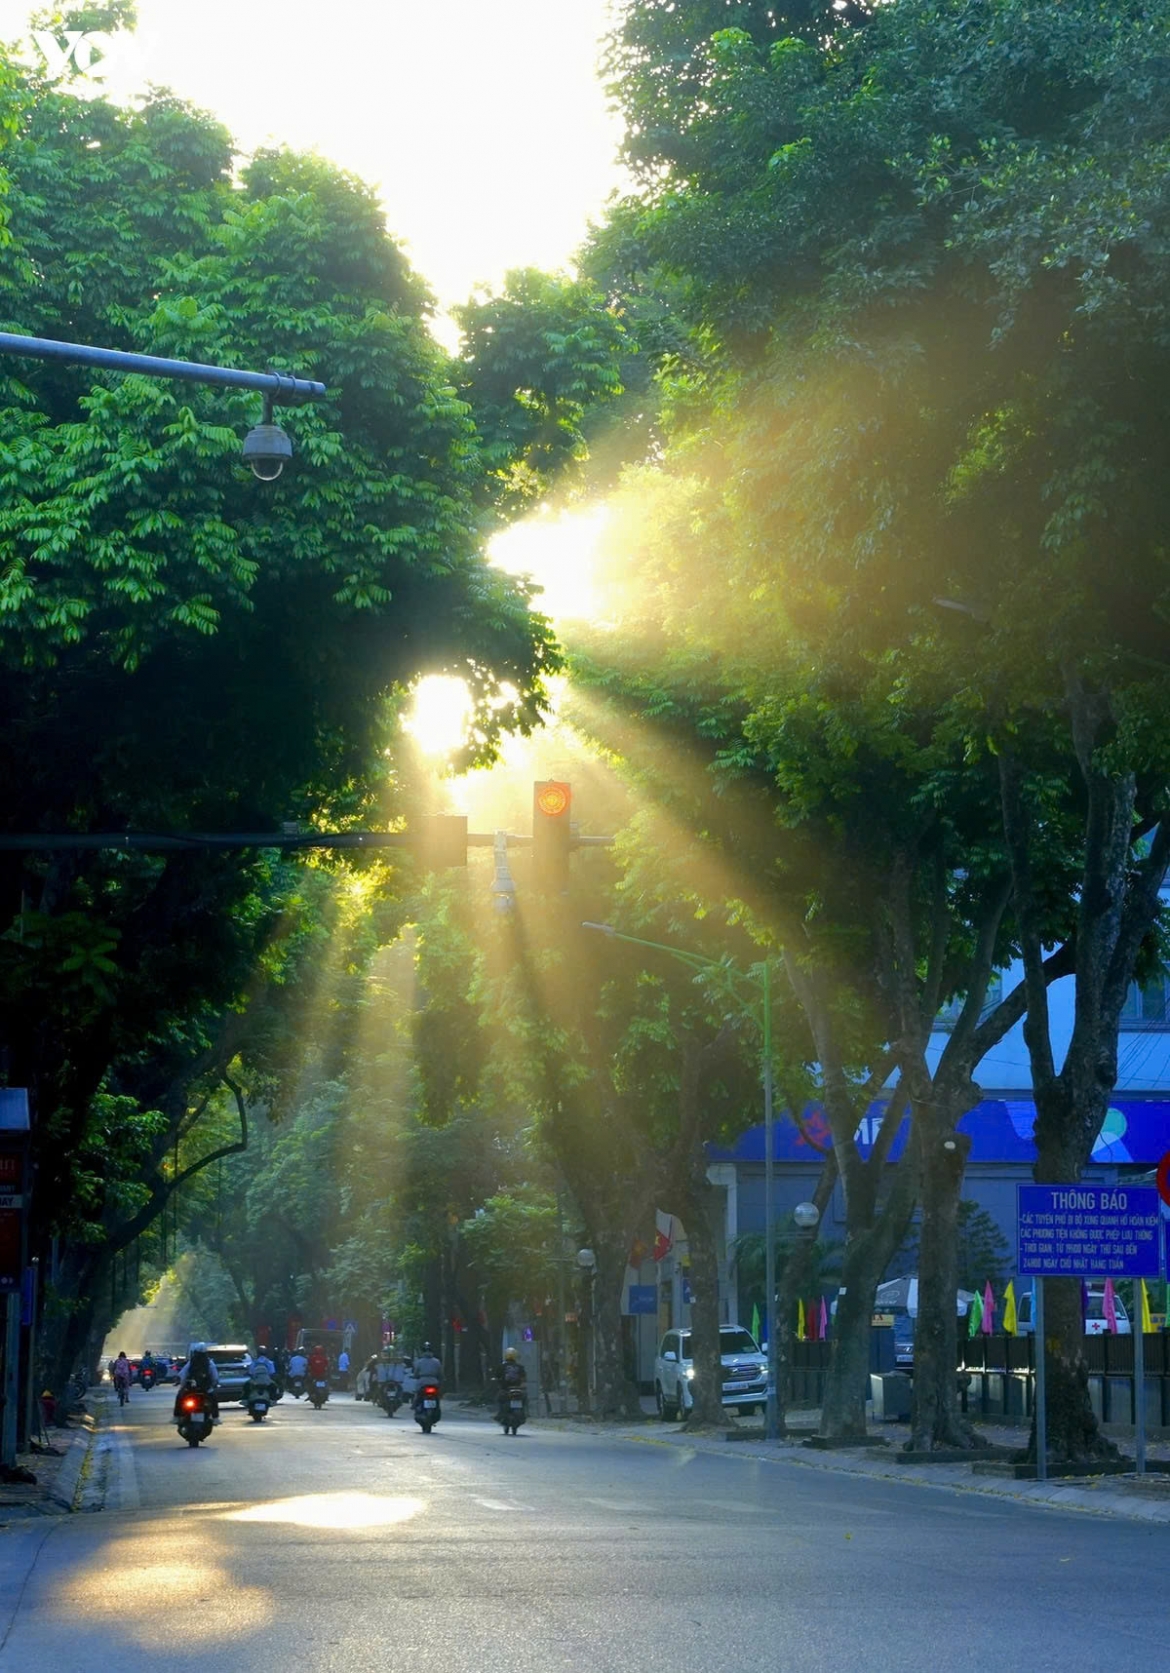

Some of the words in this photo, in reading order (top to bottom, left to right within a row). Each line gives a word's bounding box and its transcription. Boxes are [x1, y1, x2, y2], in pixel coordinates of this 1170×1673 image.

[1051, 1189, 1095, 1209] THÔNG
[1100, 1189, 1127, 1210] BÁO
[1100, 1214, 1118, 1226] QUANH
[1129, 1213, 1144, 1226] HOÀN
[1021, 1227, 1031, 1239] CÁC
[1106, 1228, 1120, 1240] PHÉP
[1083, 1241, 1097, 1254] NGÀY
[1043, 1256, 1058, 1269] NGÀY
